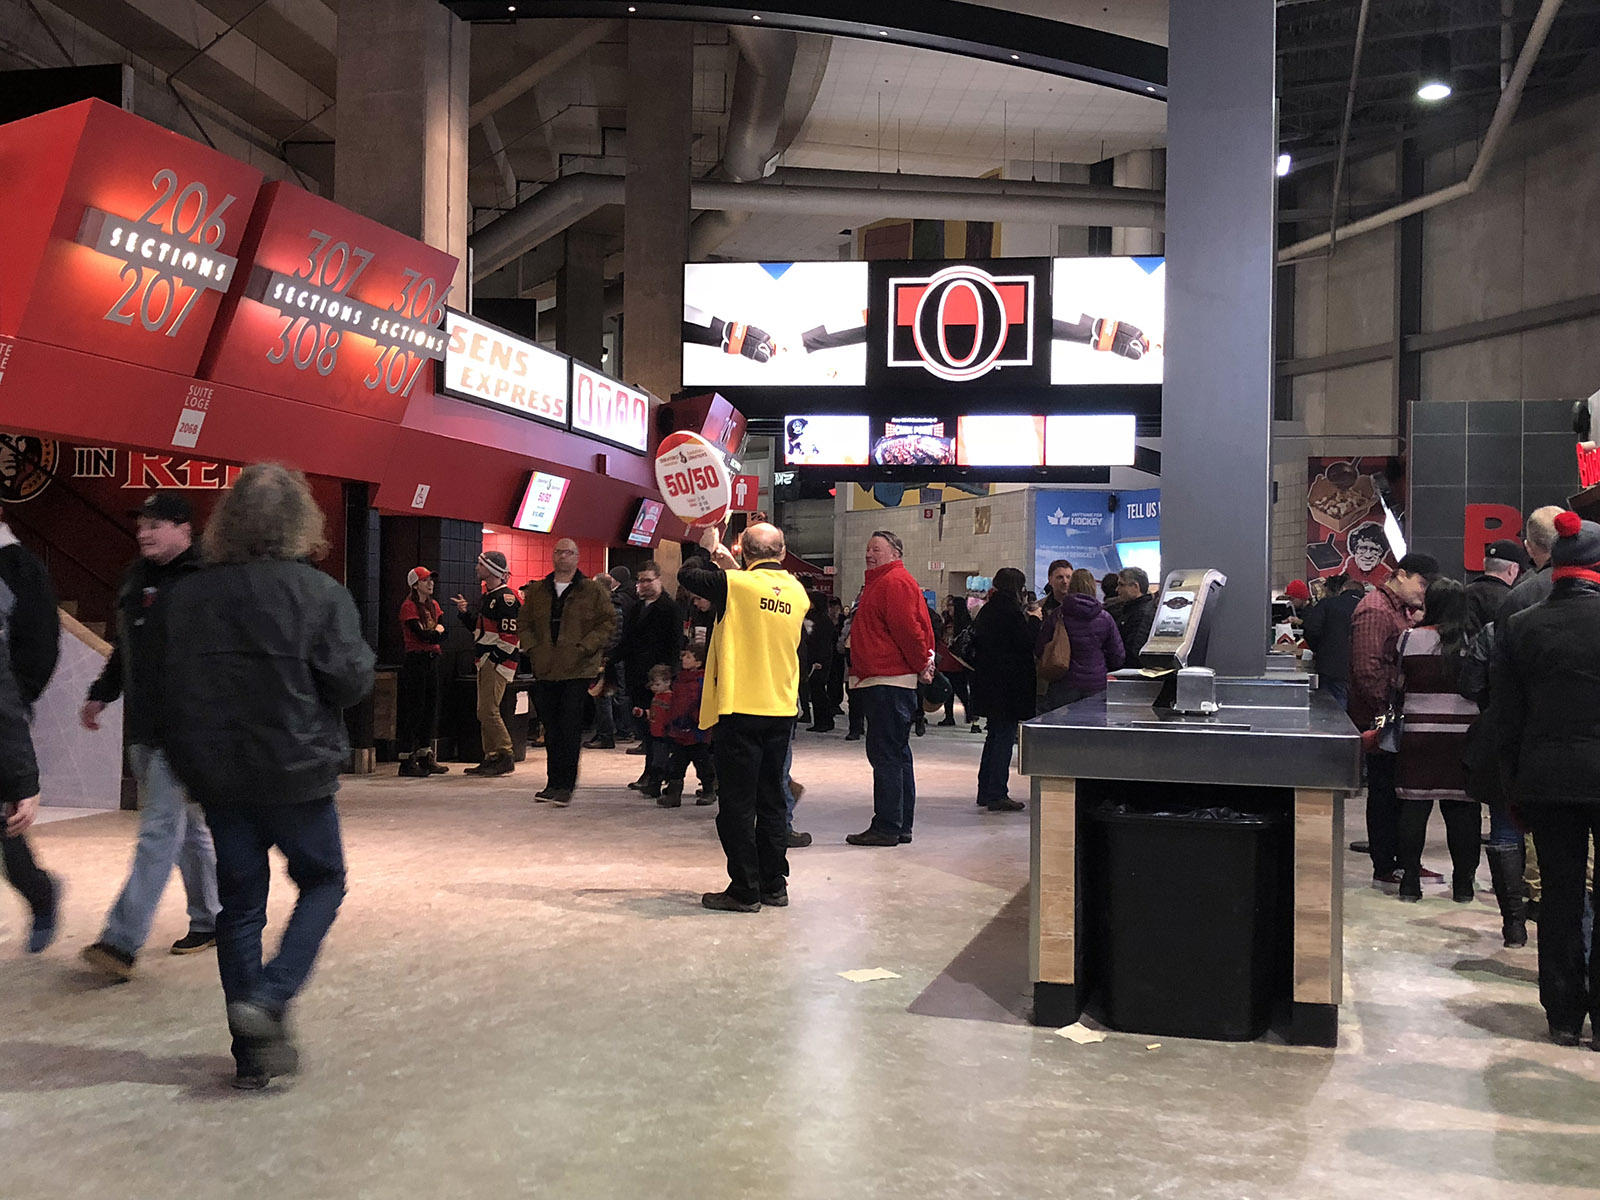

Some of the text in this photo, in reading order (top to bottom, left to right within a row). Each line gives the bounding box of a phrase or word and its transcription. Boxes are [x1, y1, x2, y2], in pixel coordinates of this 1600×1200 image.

[135, 169, 237, 250] 206
[110, 227, 227, 281] SECTIONS
[292, 229, 376, 298] 307
[103, 262, 207, 337] 207
[273, 283, 444, 353] SECTIONS SECTIONS
[388, 267, 454, 330] 306
[266, 315, 343, 377] 308
[363, 345, 428, 398] 307
[448, 325, 529, 377] SENS
[185, 396, 211, 411] LOGE
[188, 384, 214, 400] SUITE
[460, 366, 564, 418] EXPRESS
[72, 447, 118, 478] IN
[663, 465, 720, 497] 50/50
[1070, 517, 1103, 526] HOCKEY
[1127, 501, 1157, 519] TELL US
[501, 618, 517, 631] 65
[760, 597, 792, 615] 50/50
